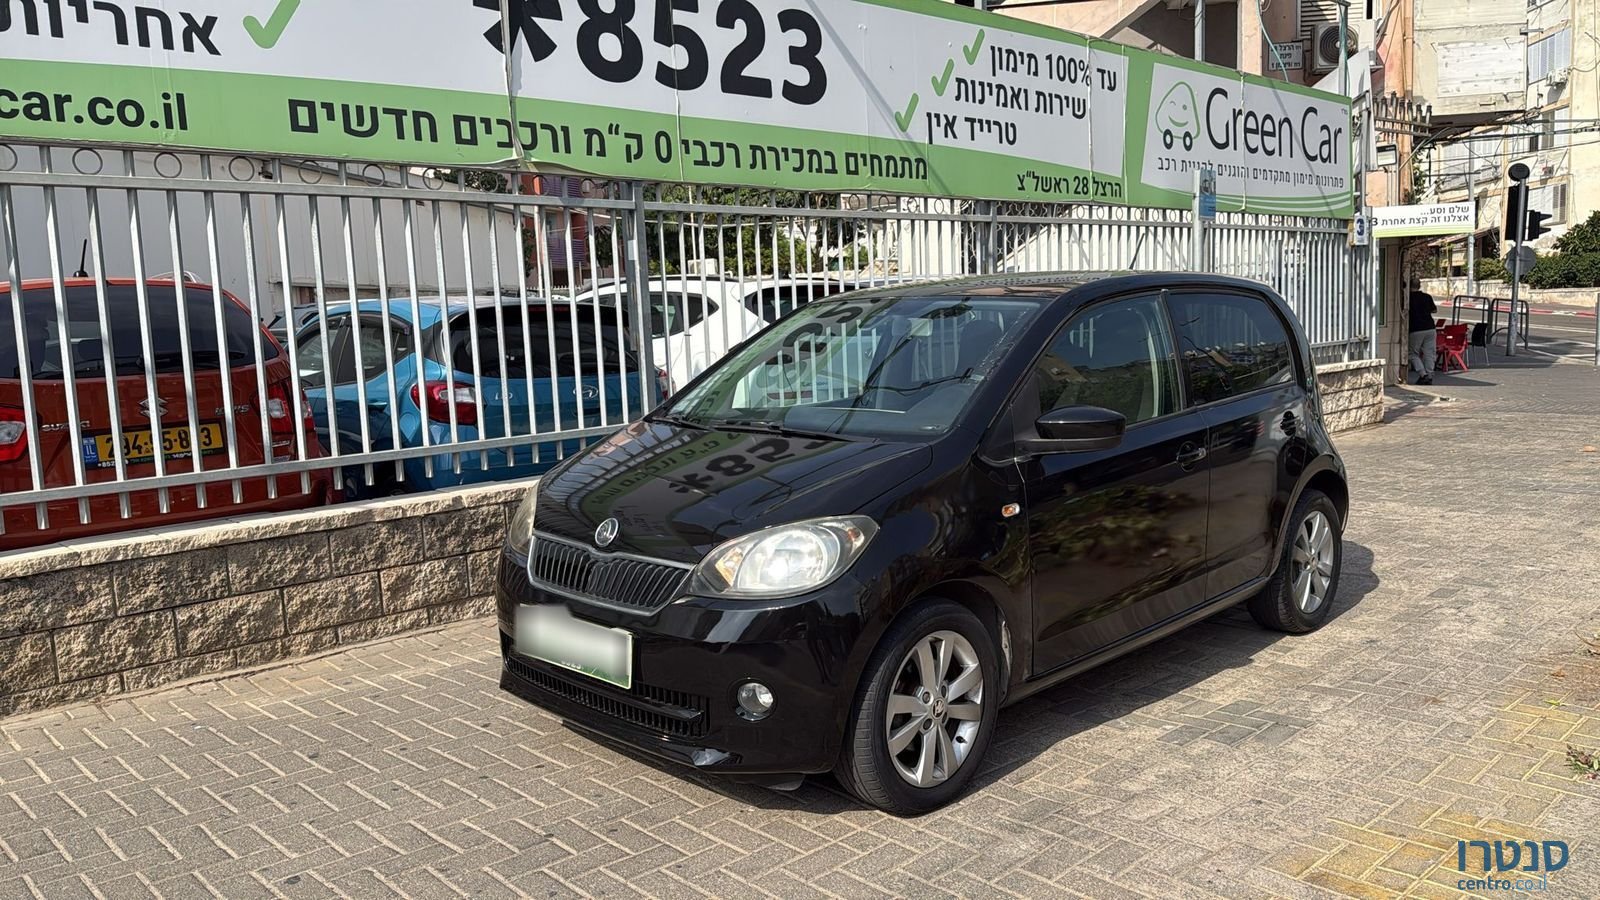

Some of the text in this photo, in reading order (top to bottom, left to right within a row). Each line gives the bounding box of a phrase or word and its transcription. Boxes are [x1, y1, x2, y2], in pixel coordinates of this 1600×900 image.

[990, 46, 1117, 91] עד 100% מימון
[955, 77, 1086, 119] שירות ואמינות
[288, 99, 438, 142] חדשים
[927, 112, 1016, 145] טרייד אין
[1206, 87, 1342, 164] Green Car
[453, 114, 572, 155] ורכבים
[655, 131, 672, 163] 0
[681, 139, 740, 168] רכבי
[750, 145, 838, 175] במכירת
[845, 152, 927, 180] מתמחים
[1157, 157, 1177, 171] רכב
[1217, 163, 1249, 179] והוגנים
[1252, 168, 1290, 184] מתקדמים
[1293, 173, 1313, 187] מימון
[1073, 176, 1089, 195] 28
[1092, 176, 1122, 198] הרצל
[1315, 175, 1344, 188] פתרונות
[1444, 214, 1469, 223] אצלנו
[1448, 205, 1469, 214] שלם
[1356, 218, 1365, 236] 3
[1381, 217, 1406, 226] אחרת
[1409, 217, 1428, 226] קצת
